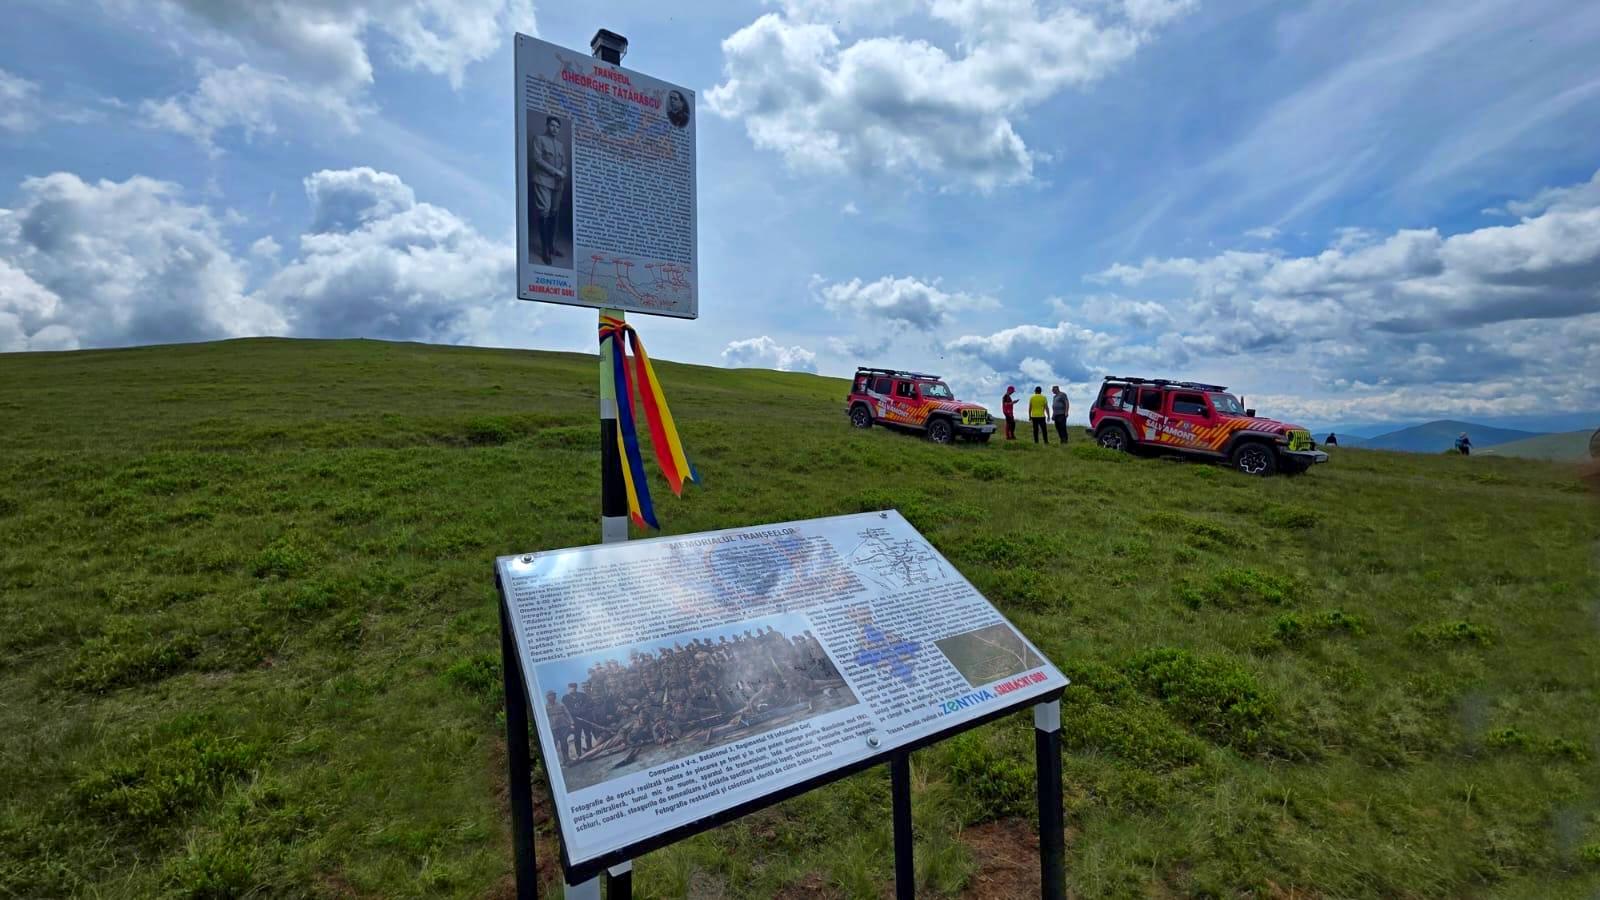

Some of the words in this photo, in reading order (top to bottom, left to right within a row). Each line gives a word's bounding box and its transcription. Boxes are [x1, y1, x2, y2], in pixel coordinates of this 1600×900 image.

[561, 70, 610, 94] GHEORGHE
[1145, 419, 1197, 441] SALVAMONT
[669, 535, 737, 551] MEMORIALUL
[648, 763, 680, 779] Compania
[570, 798, 604, 815] Fotografie
[615, 788, 636, 800] epocă
[654, 799, 688, 817] Fotografie
[688, 788, 720, 804] restaurată
[658, 796, 667, 804] de
